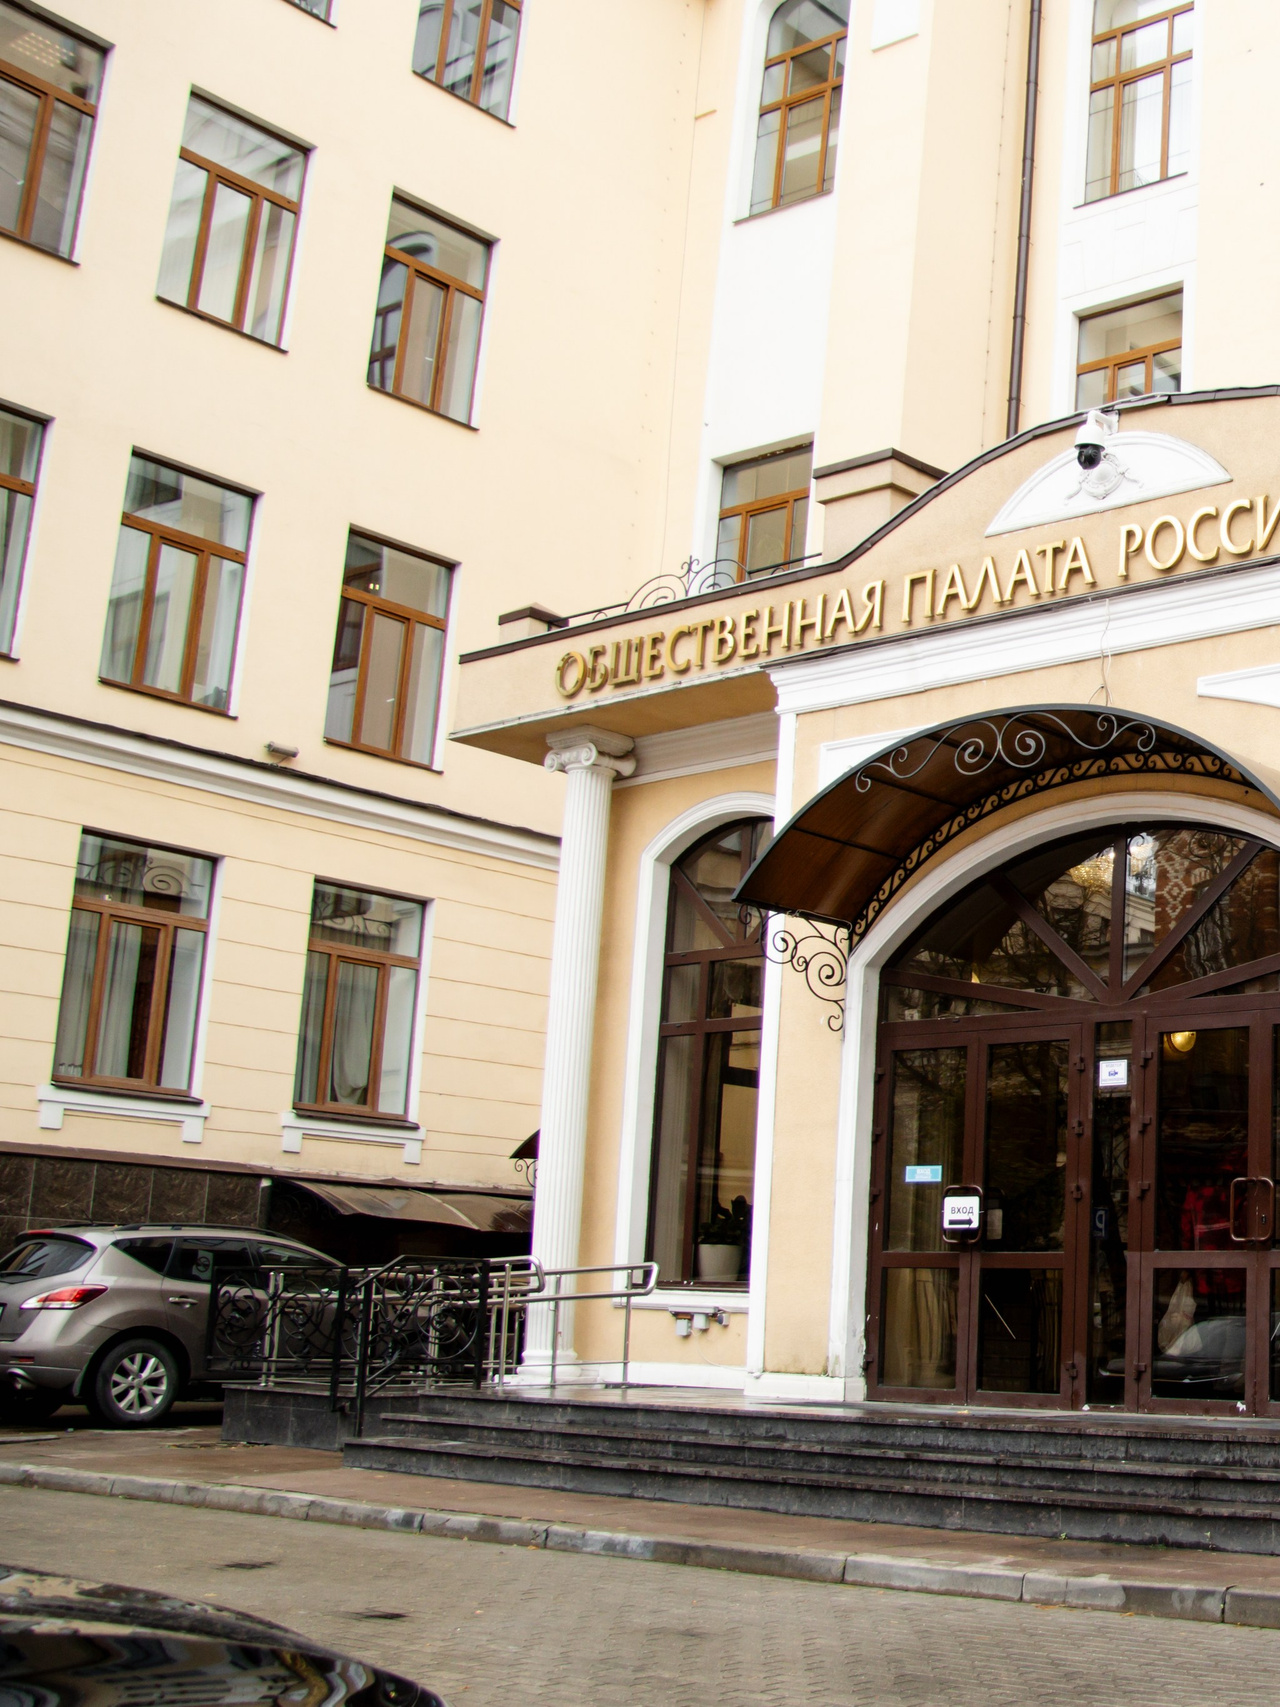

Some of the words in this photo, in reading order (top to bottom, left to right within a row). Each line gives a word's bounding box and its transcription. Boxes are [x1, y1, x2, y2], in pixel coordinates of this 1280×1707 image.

[555, 577, 886, 697] ОБЩЕСТВЕННАЯ
[901, 535, 1098, 624] ПАЛАТА
[950, 1206, 975, 1216] ВХОД
